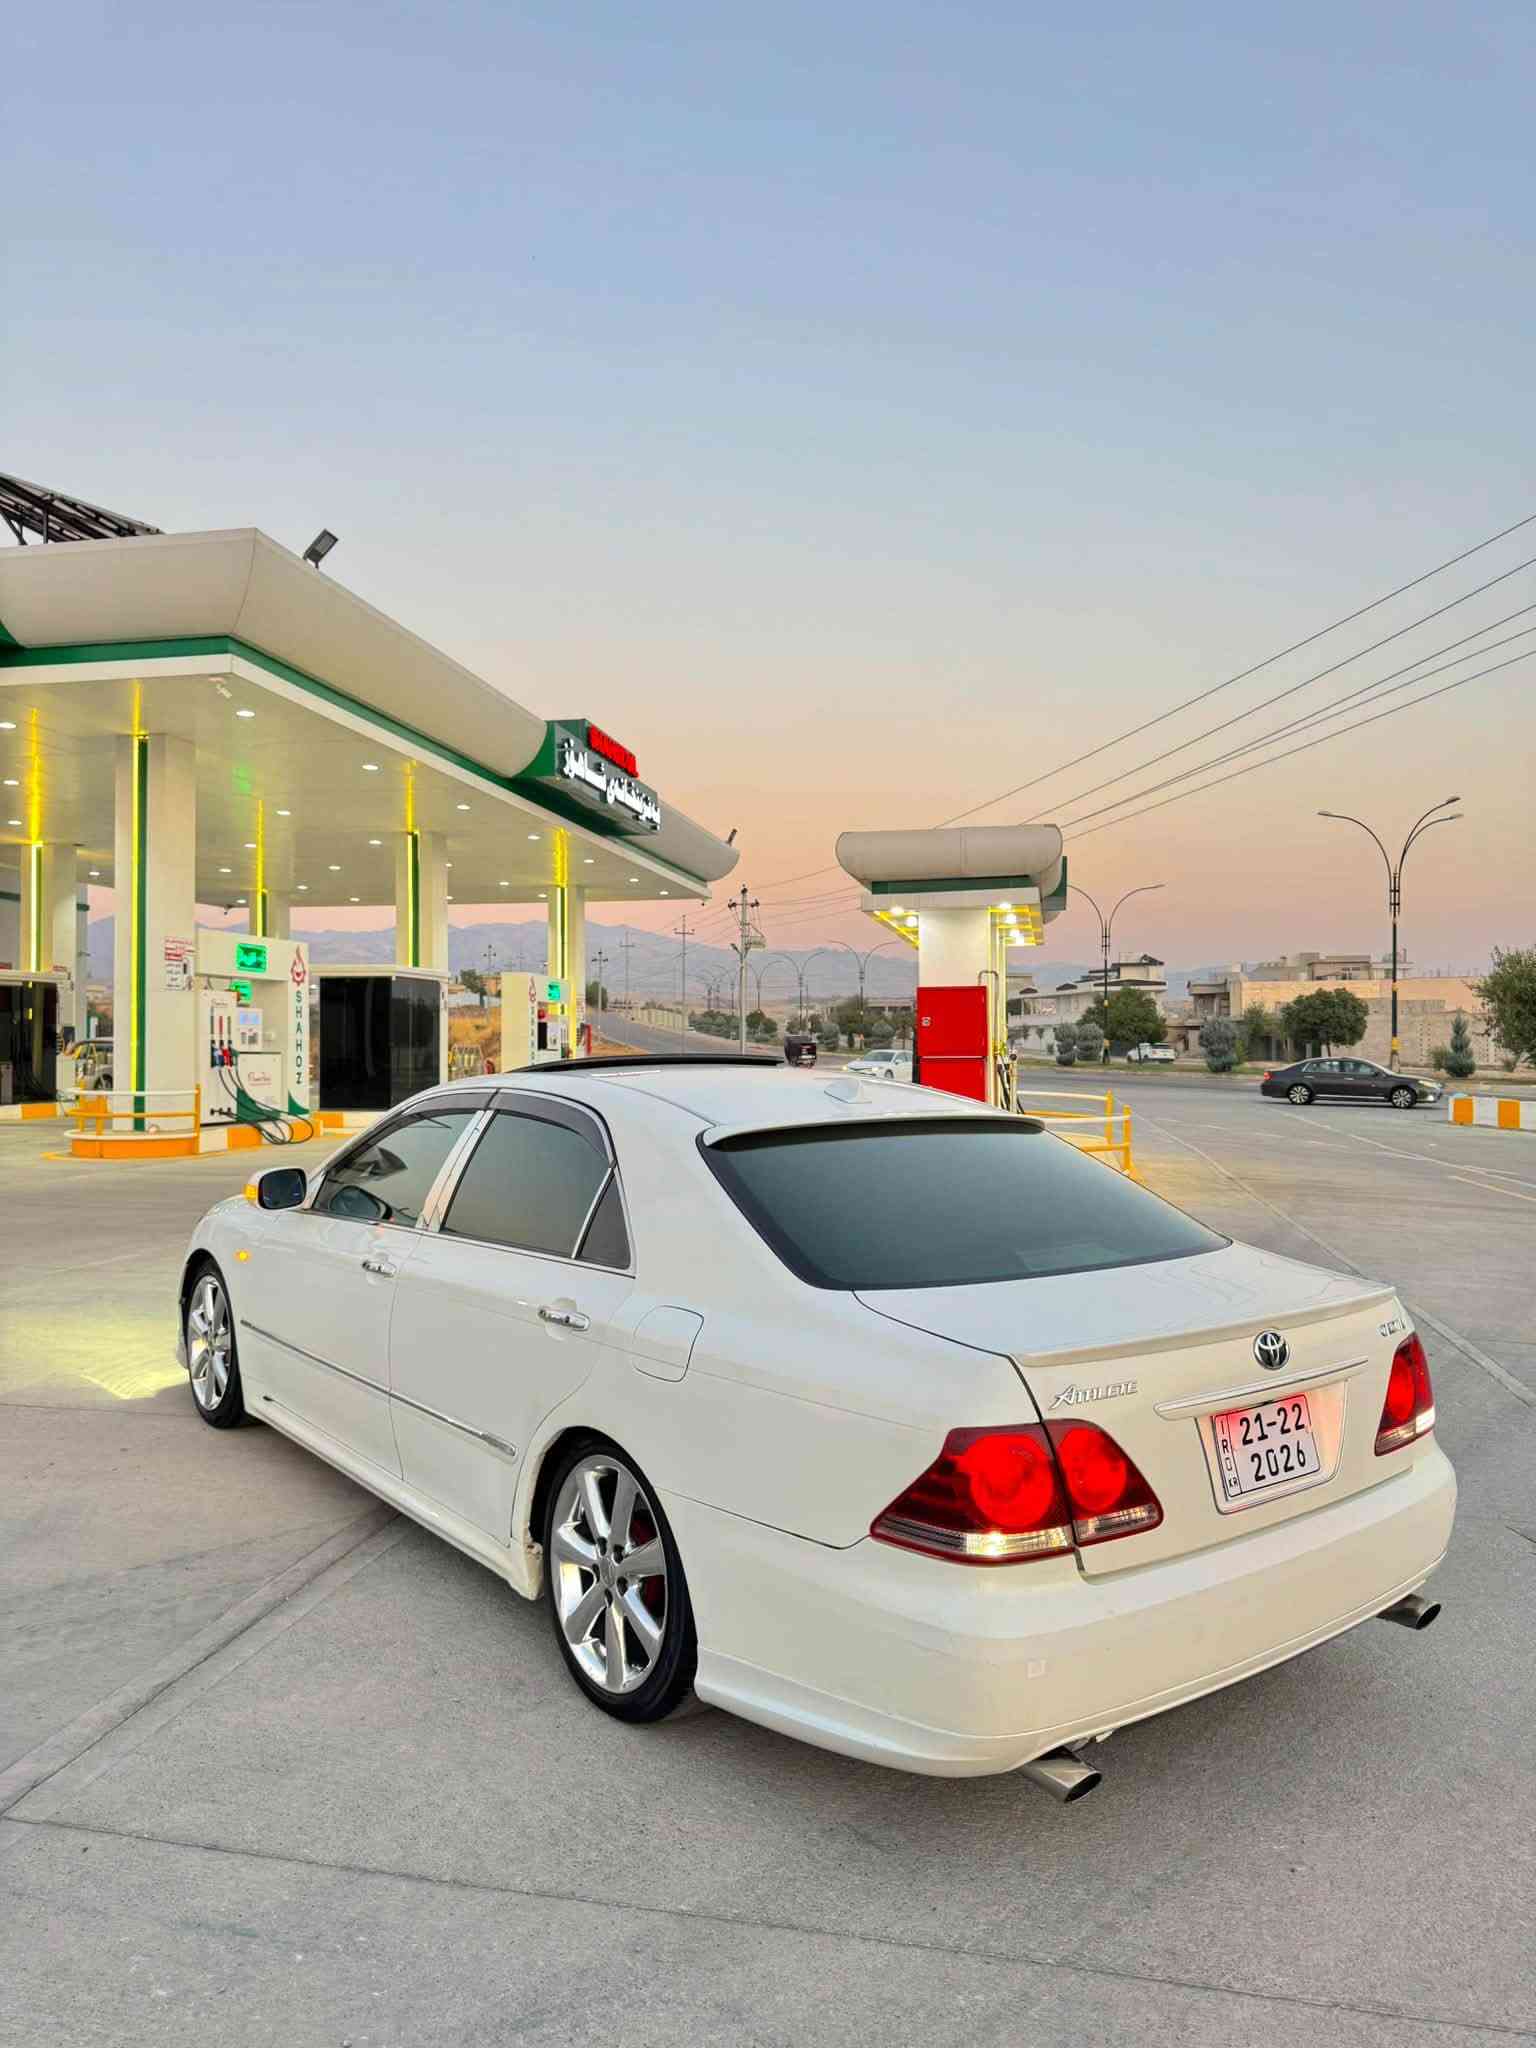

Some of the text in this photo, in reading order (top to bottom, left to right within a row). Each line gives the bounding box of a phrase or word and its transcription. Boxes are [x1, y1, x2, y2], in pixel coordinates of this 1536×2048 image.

[295, 990, 304, 1085] SHAHOZ
[1239, 1402, 1305, 1446] 21-22
[1250, 1440, 1307, 1482] 2026
